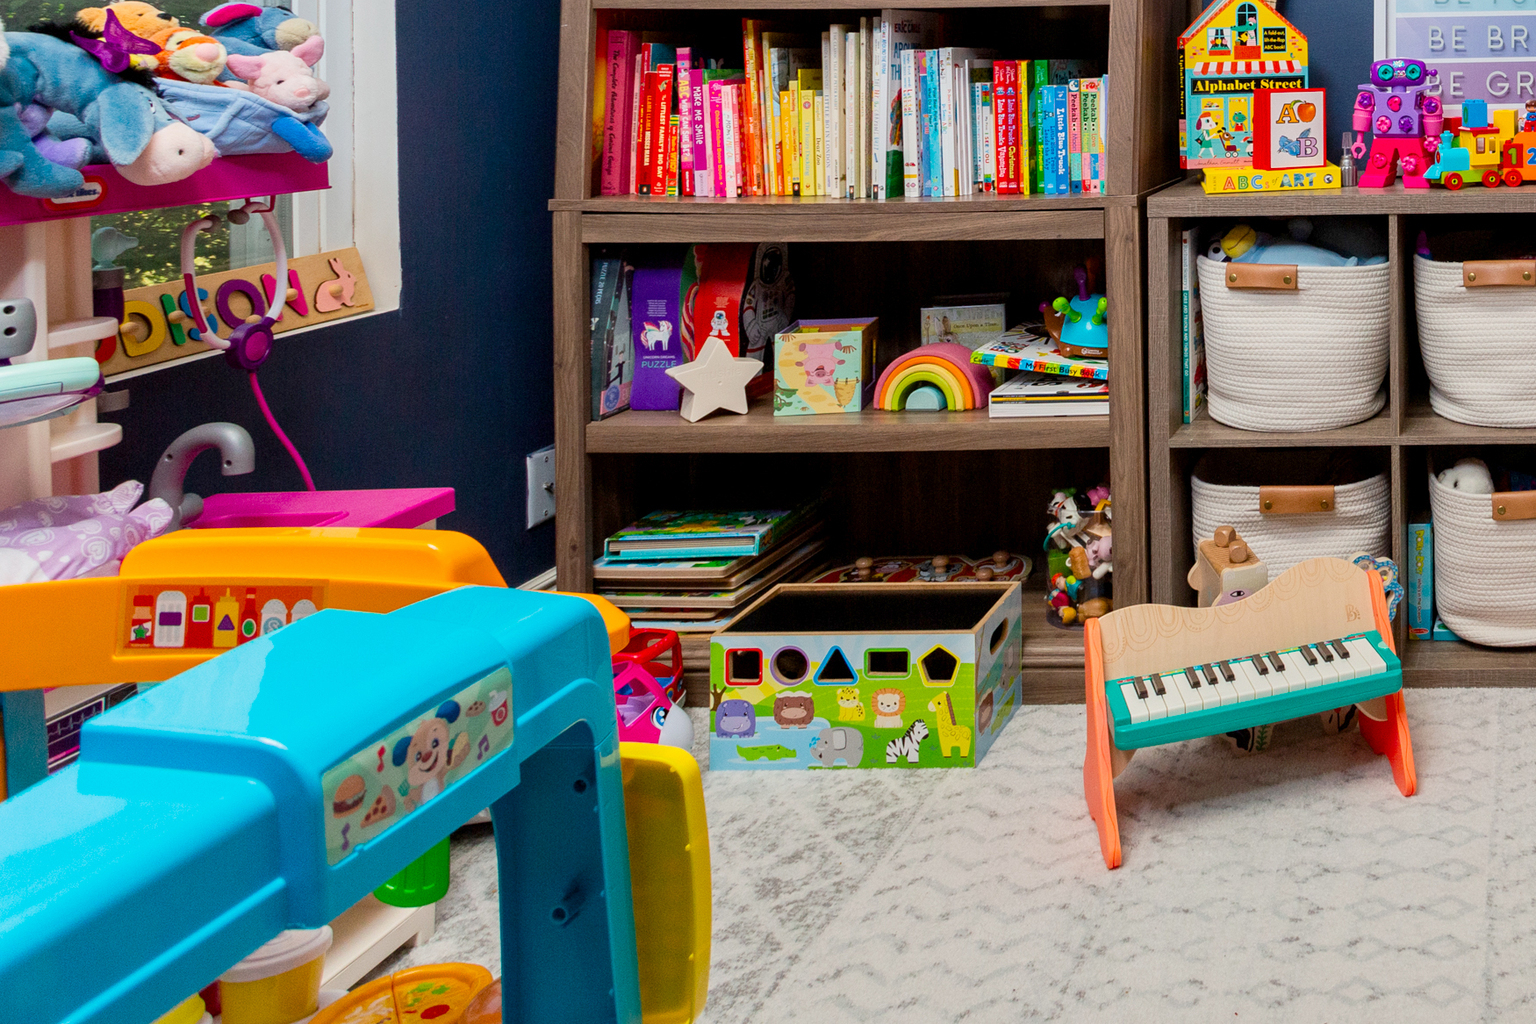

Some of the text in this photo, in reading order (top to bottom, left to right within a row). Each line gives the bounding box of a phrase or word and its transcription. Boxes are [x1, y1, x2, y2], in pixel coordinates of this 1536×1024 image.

[1428, 25, 1468, 50] BE
[612, 50, 620, 61] The
[678, 80, 689, 98] ABC
[1194, 79, 1302, 94] Alphabet Street
[1426, 72, 1464, 97] BE
[609, 91, 617, 124] Adventures
[1276, 103, 1299, 124] A
[681, 116, 689, 129] CAN
[1057, 108, 1065, 129] Little
[682, 145, 690, 156] BE?
[1296, 137, 1319, 158] B
[1508, 147, 1517, 165] 1
[1272, 177, 1279, 185] of
[1280, 173, 1317, 188] ART
[1025, 363, 1100, 377] My First Busy Book
